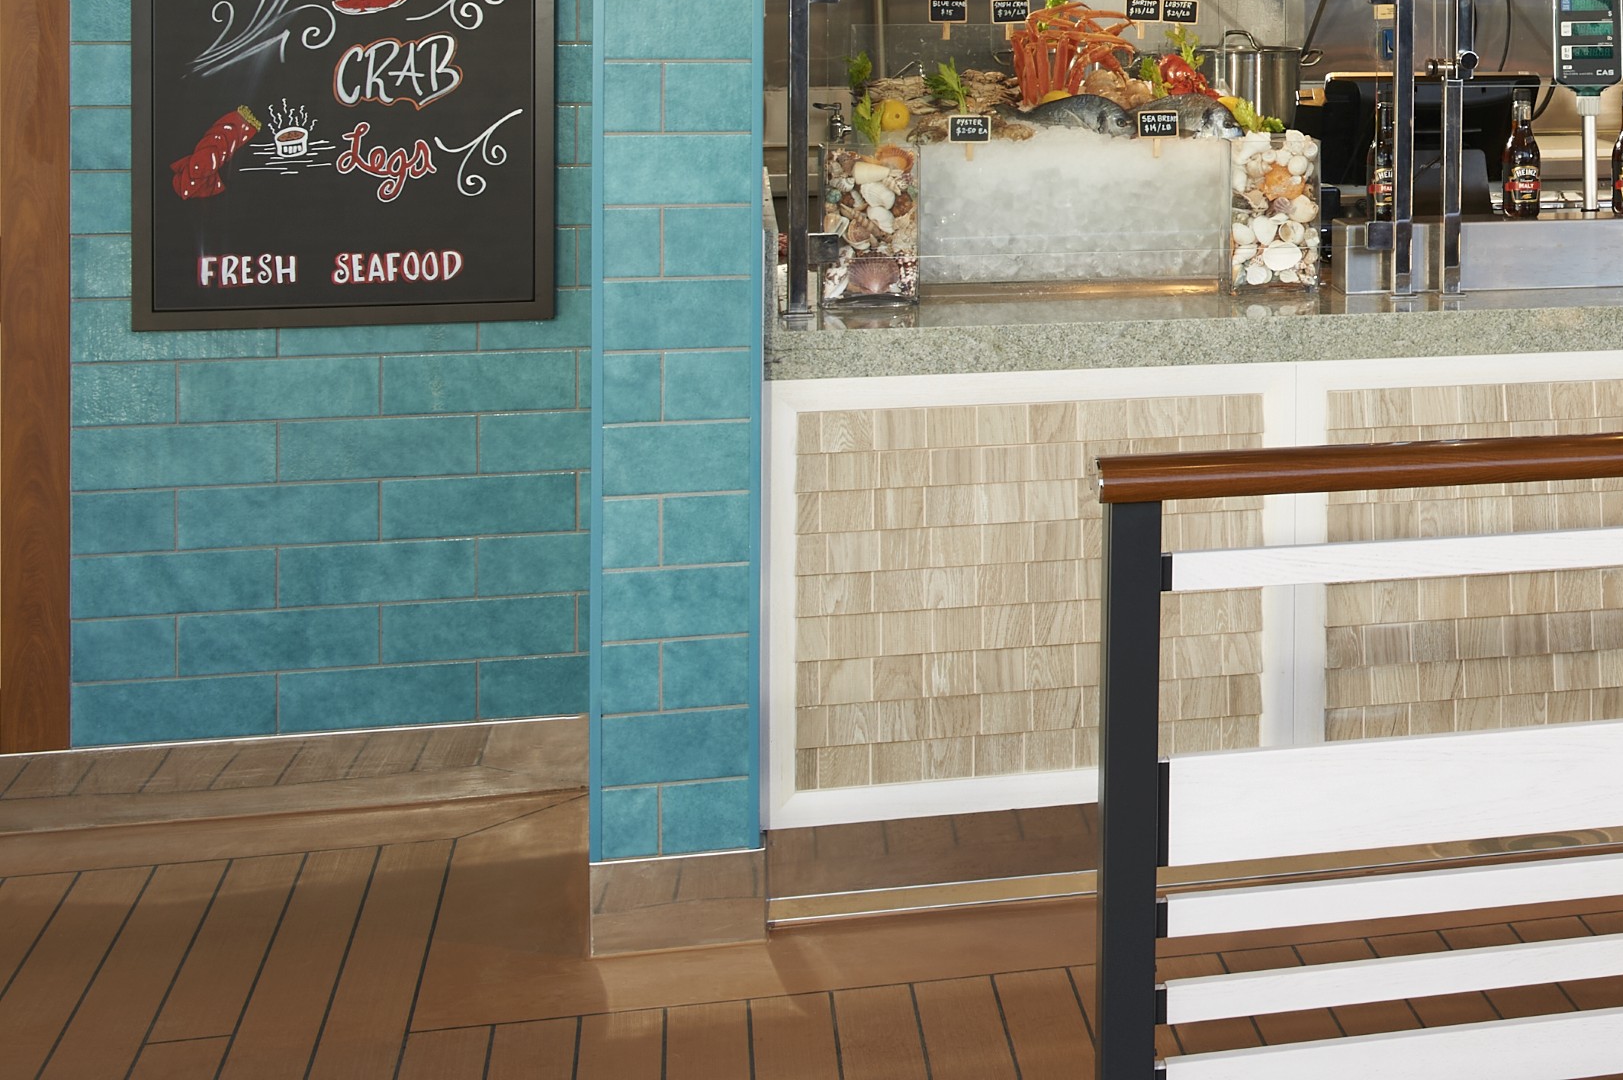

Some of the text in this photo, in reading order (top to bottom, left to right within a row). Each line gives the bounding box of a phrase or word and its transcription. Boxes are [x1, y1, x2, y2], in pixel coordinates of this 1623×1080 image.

[1132, 0, 1157, 7] SHRIMP
[1165, 1, 1192, 9] LOBSTER
[335, 34, 461, 107] CRAB
[956, 119, 984, 127] OYSTER
[1142, 115, 1156, 123] SEA
[1516, 168, 1537, 177] HEINZ
[200, 251, 463, 286] FRESH SEAFOOD
